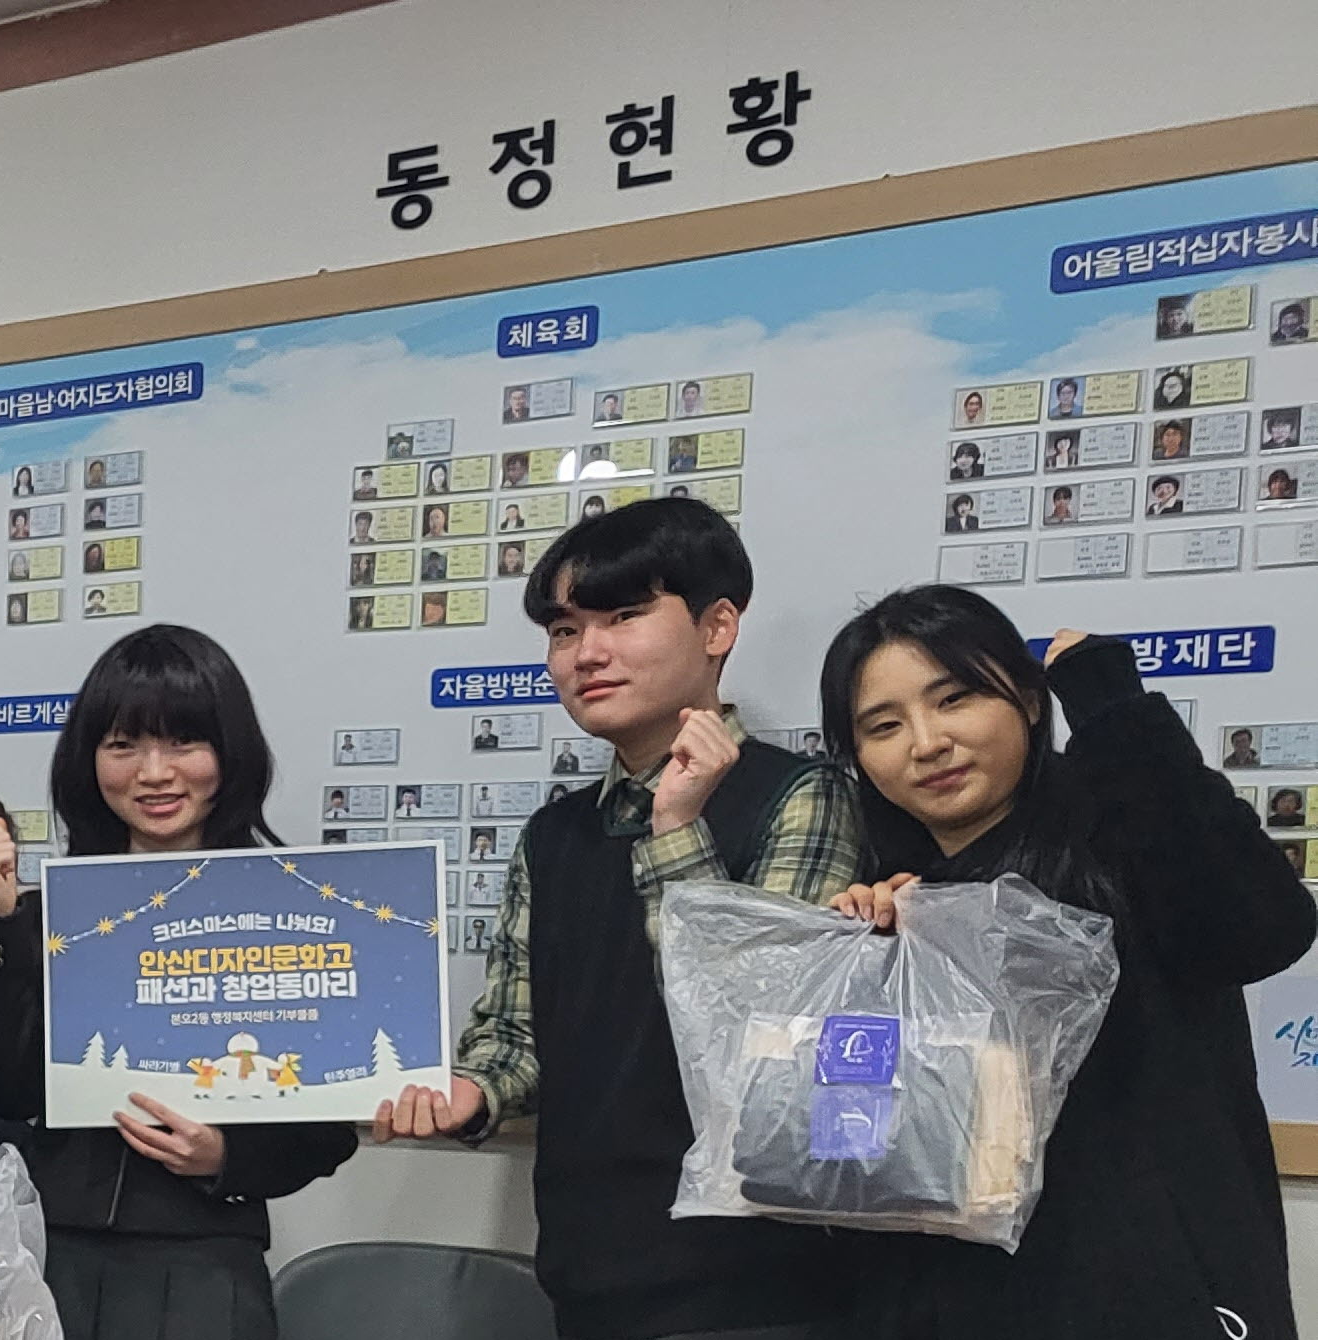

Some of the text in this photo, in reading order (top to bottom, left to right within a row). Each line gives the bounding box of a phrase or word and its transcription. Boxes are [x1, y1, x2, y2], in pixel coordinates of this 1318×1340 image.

[375, 70, 811, 230] 동정현황
[1064, 217, 1318, 281] 어울림적십자봉사
[507, 312, 589, 349] 체육회
[152, 911, 336, 943] 크리스마스에는 나눠요!
[139, 943, 353, 976] 안산디자인문화고
[135, 971, 358, 1005] 패션과 창업동아리
[170, 1012, 209, 1026] 본오2동
[211, 1008, 274, 1024] 행정복지센터
